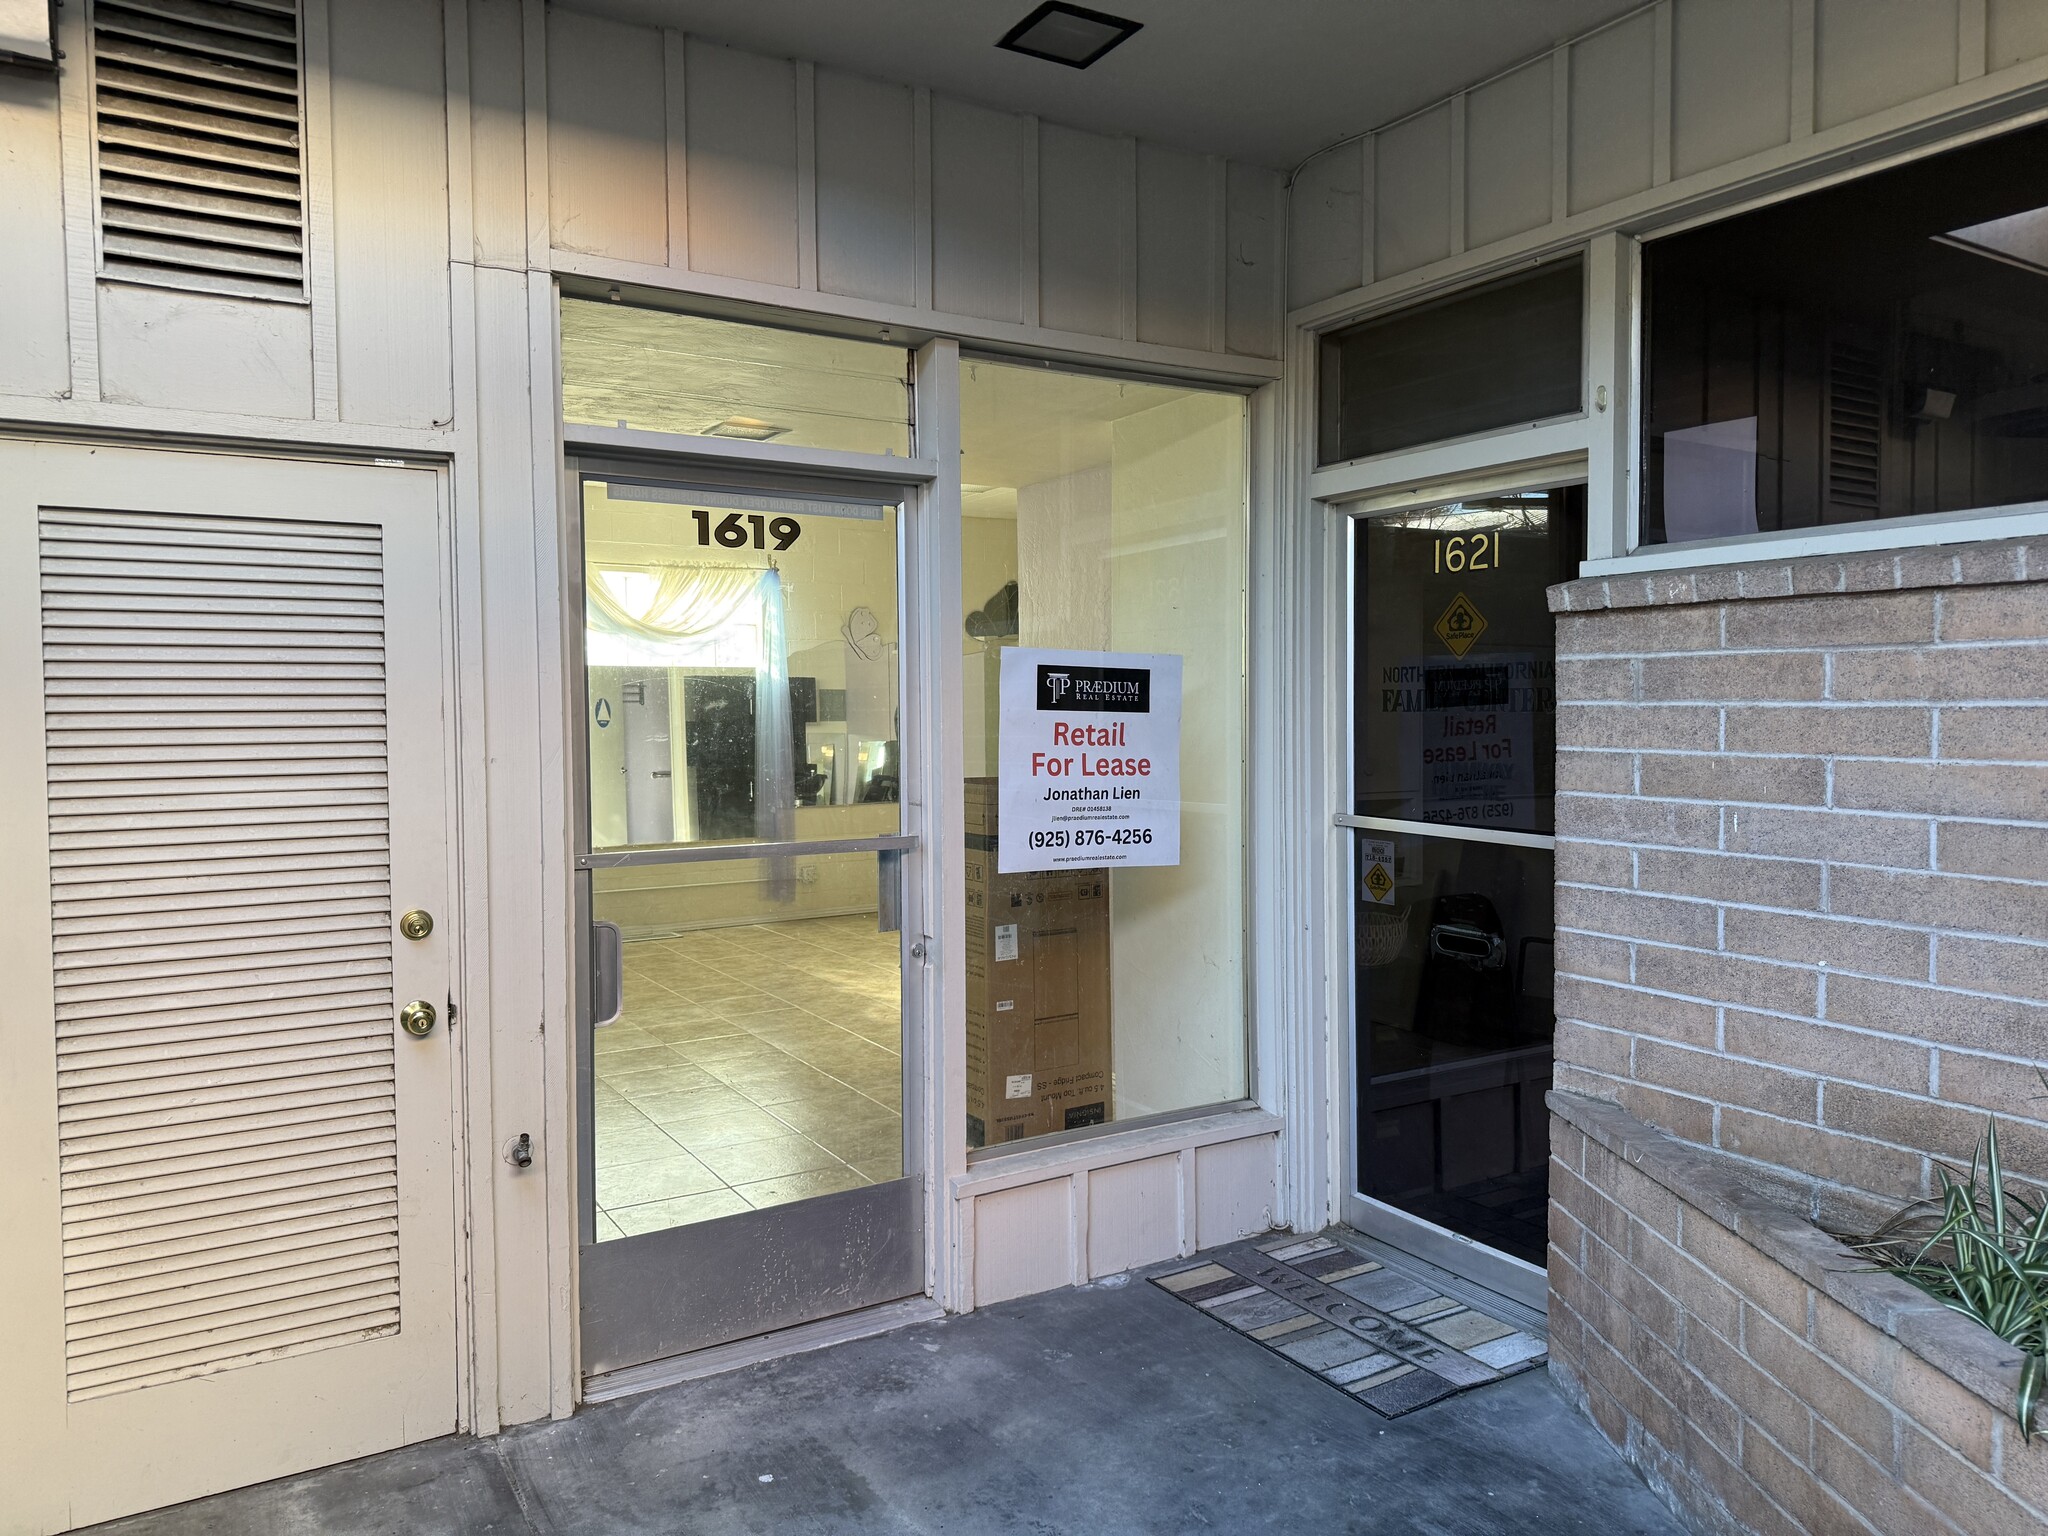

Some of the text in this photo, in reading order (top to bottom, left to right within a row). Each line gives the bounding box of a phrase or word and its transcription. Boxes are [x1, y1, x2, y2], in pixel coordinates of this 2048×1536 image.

[691, 510, 801, 551] 1619
[1434, 531, 1499, 574] 1621
[1076, 693, 1139, 702] REAL ESTATE
[1053, 722, 1126, 747] Retail
[1032, 752, 1151, 777] For Lease
[1043, 786, 1141, 801] Jonathan Lien
[1028, 828, 1153, 850] (925) 876-4256
[1053, 1075, 1074, 1086] Fridge
[1063, 1089, 1076, 1097] Top
[1256, 1265, 1447, 1364] WELCOME
